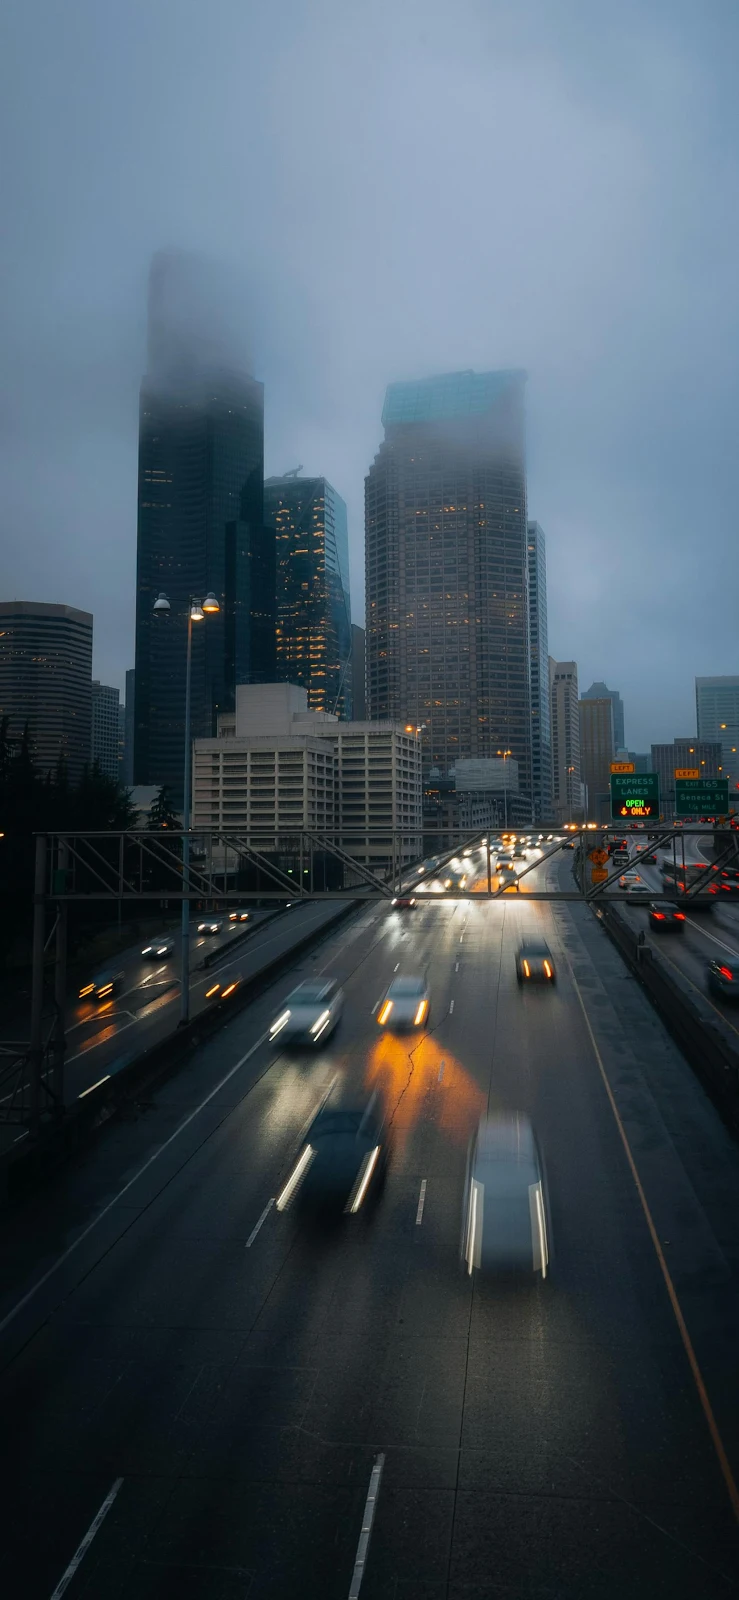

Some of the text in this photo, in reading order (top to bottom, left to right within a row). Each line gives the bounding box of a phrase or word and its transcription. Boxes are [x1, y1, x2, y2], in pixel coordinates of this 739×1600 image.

[702, 780, 718, 788] 165
[680, 793, 724, 801] Seneca St
[625, 799, 645, 807] OPEN
[631, 807, 650, 815] ONLY
